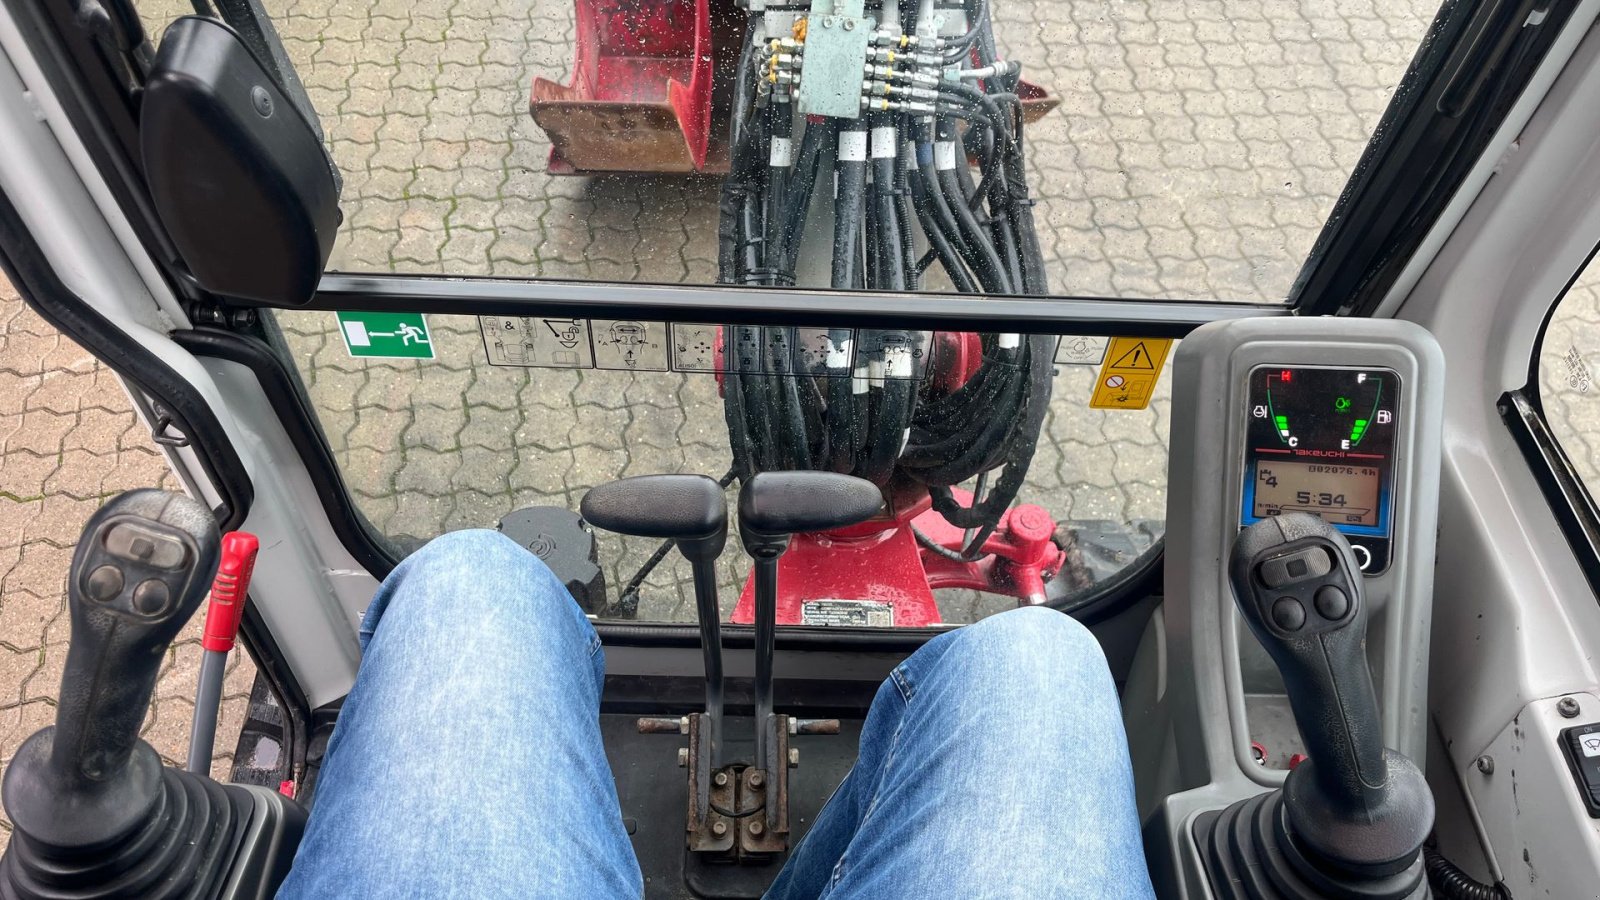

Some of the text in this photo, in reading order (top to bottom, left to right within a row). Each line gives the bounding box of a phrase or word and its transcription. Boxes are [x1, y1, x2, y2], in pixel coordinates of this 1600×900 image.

[1281, 371, 1292, 382] H
[1357, 373, 1367, 383] F
[1288, 436, 1298, 447] C
[1341, 439, 1350, 449] E
[1296, 491, 1347, 507] 5:34
